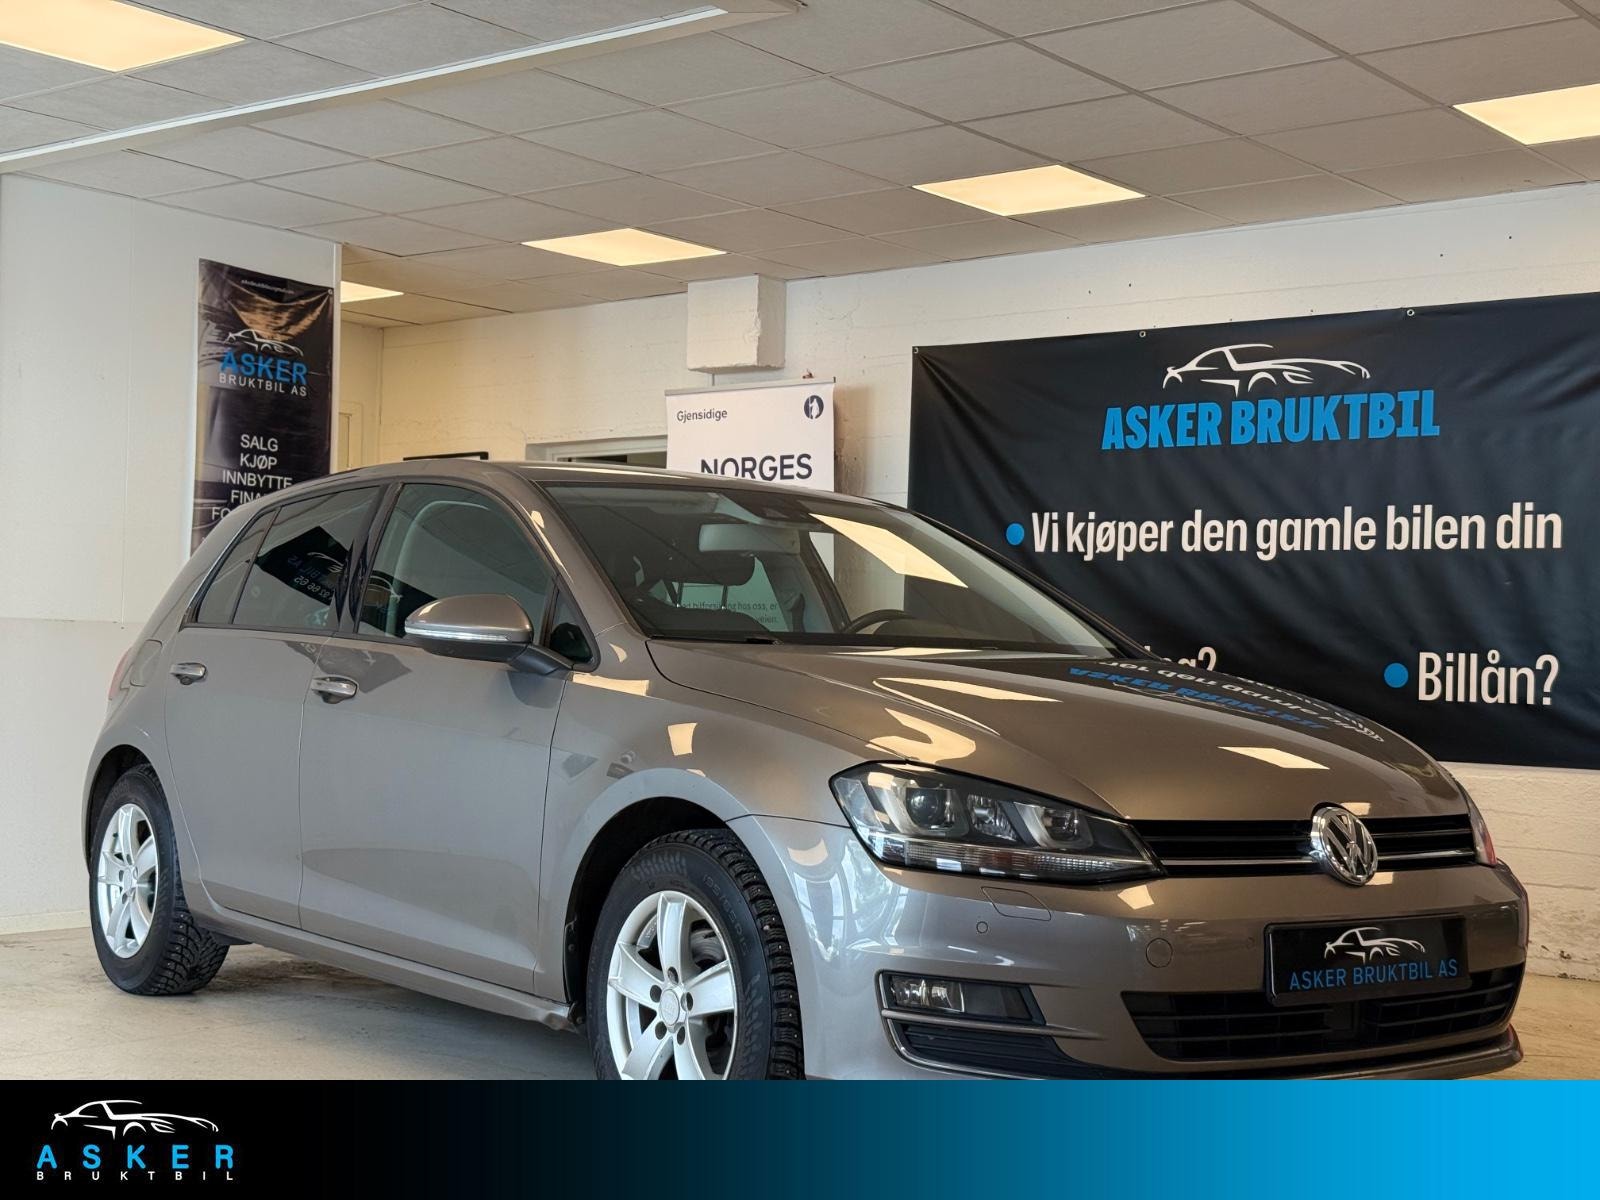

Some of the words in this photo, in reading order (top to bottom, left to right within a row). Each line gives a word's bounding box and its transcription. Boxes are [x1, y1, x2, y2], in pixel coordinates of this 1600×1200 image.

[219, 348, 308, 386] ASKER
[219, 373, 285, 394] BRUKTBIL
[290, 385, 308, 397] AS
[676, 408, 728, 423] Gjensidige
[1101, 402, 1221, 450] ASKER
[1229, 389, 1441, 445] BRUKTBIL
[240, 434, 279, 452] SALG
[240, 453, 278, 470] KJØP
[700, 453, 813, 482] NORGES
[222, 469, 293, 489] INNBYTTE
[231, 489, 269, 504] FINA
[1031, 511, 1060, 553] Vi
[1065, 511, 1174, 562] kjøper
[1180, 509, 1249, 552] den
[1255, 506, 1377, 560] gamle
[1386, 504, 1486, 551] bilen
[1495, 502, 1563, 550] din
[1417, 649, 1560, 706] Billån?
[1290, 968, 1347, 990] ASKER
[1353, 961, 1432, 985] BRUKTBIL
[1438, 958, 1458, 977] AS
